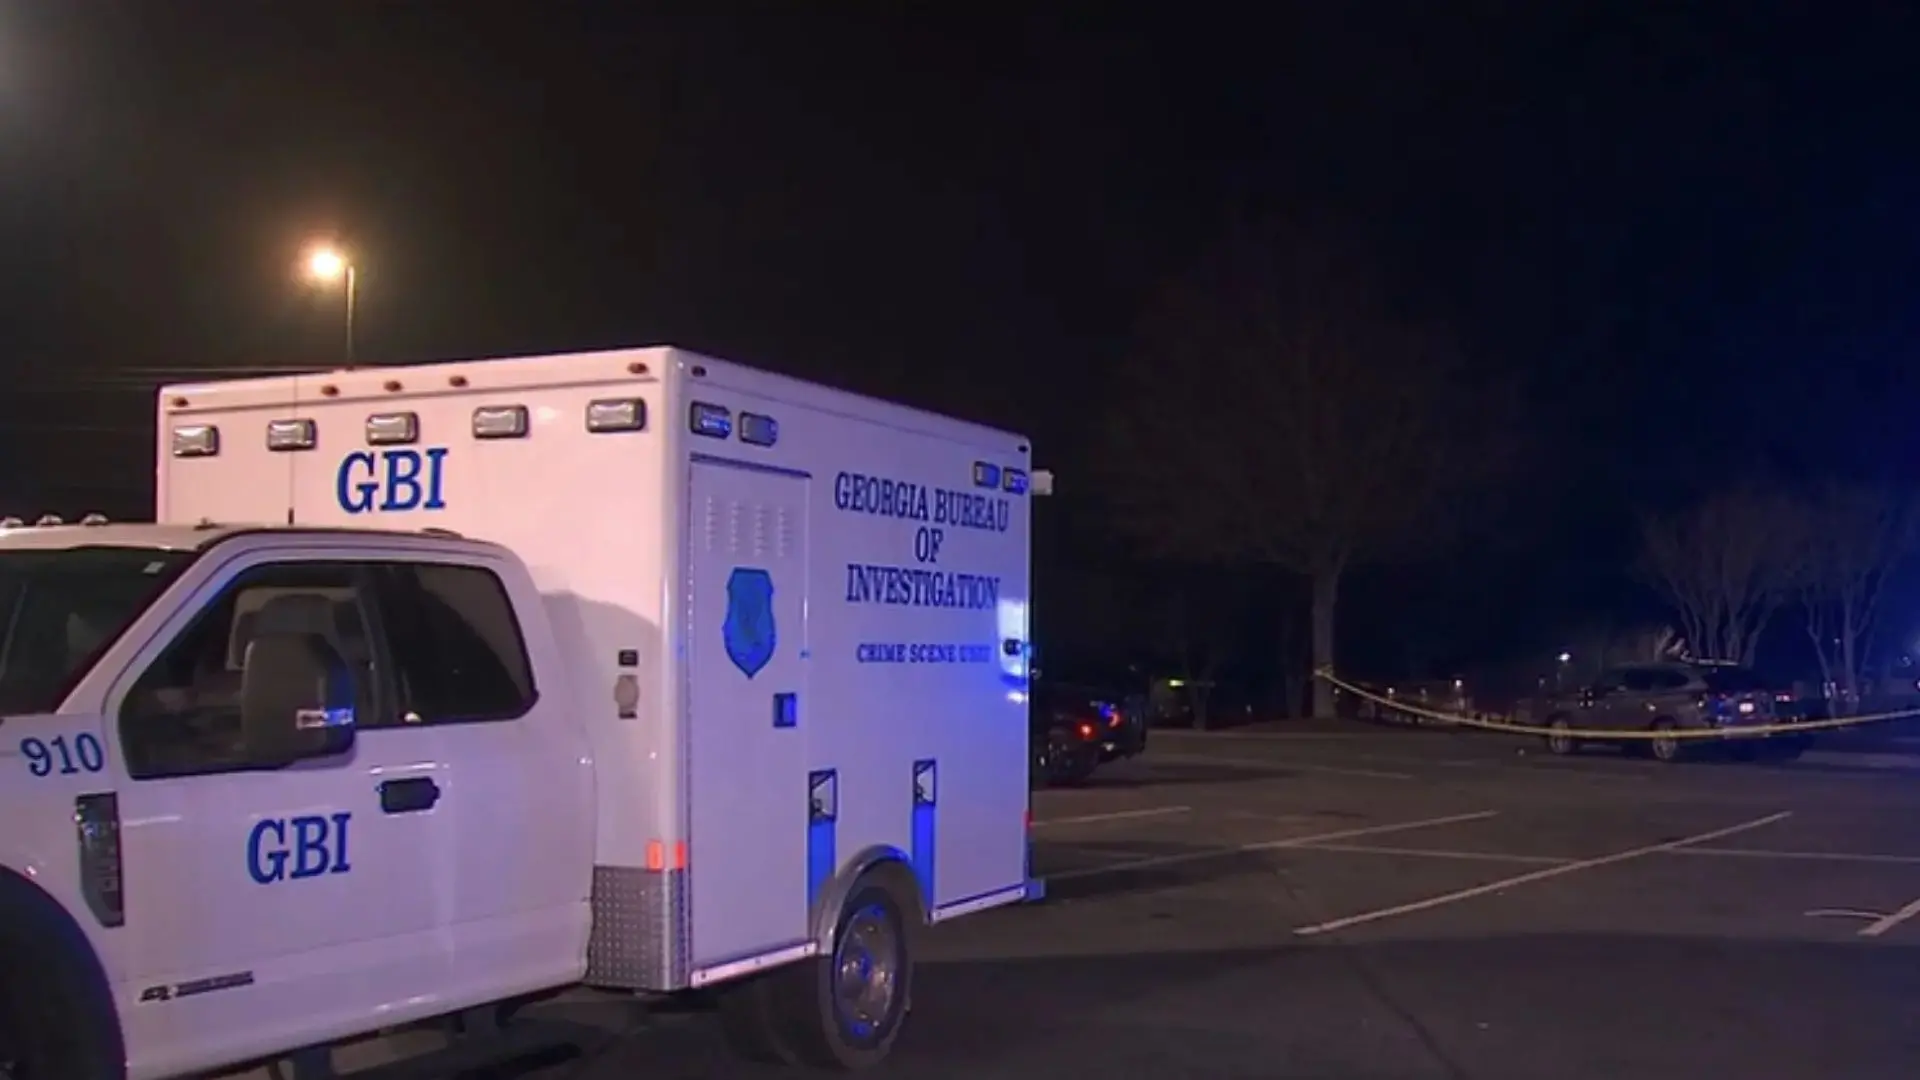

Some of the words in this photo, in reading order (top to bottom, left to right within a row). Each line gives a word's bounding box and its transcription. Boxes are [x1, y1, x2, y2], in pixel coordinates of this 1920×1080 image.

[337, 448, 448, 514] GBI
[835, 471, 929, 521] GEORGIA
[935, 489, 1009, 532] BUREAU
[915, 527, 944, 562] OF
[846, 564, 1000, 609] INVESTIGATION
[857, 643, 905, 663] CRIME
[910, 643, 956, 663] SCENE
[20, 732, 104, 777] 910
[247, 813, 352, 884] GBI
